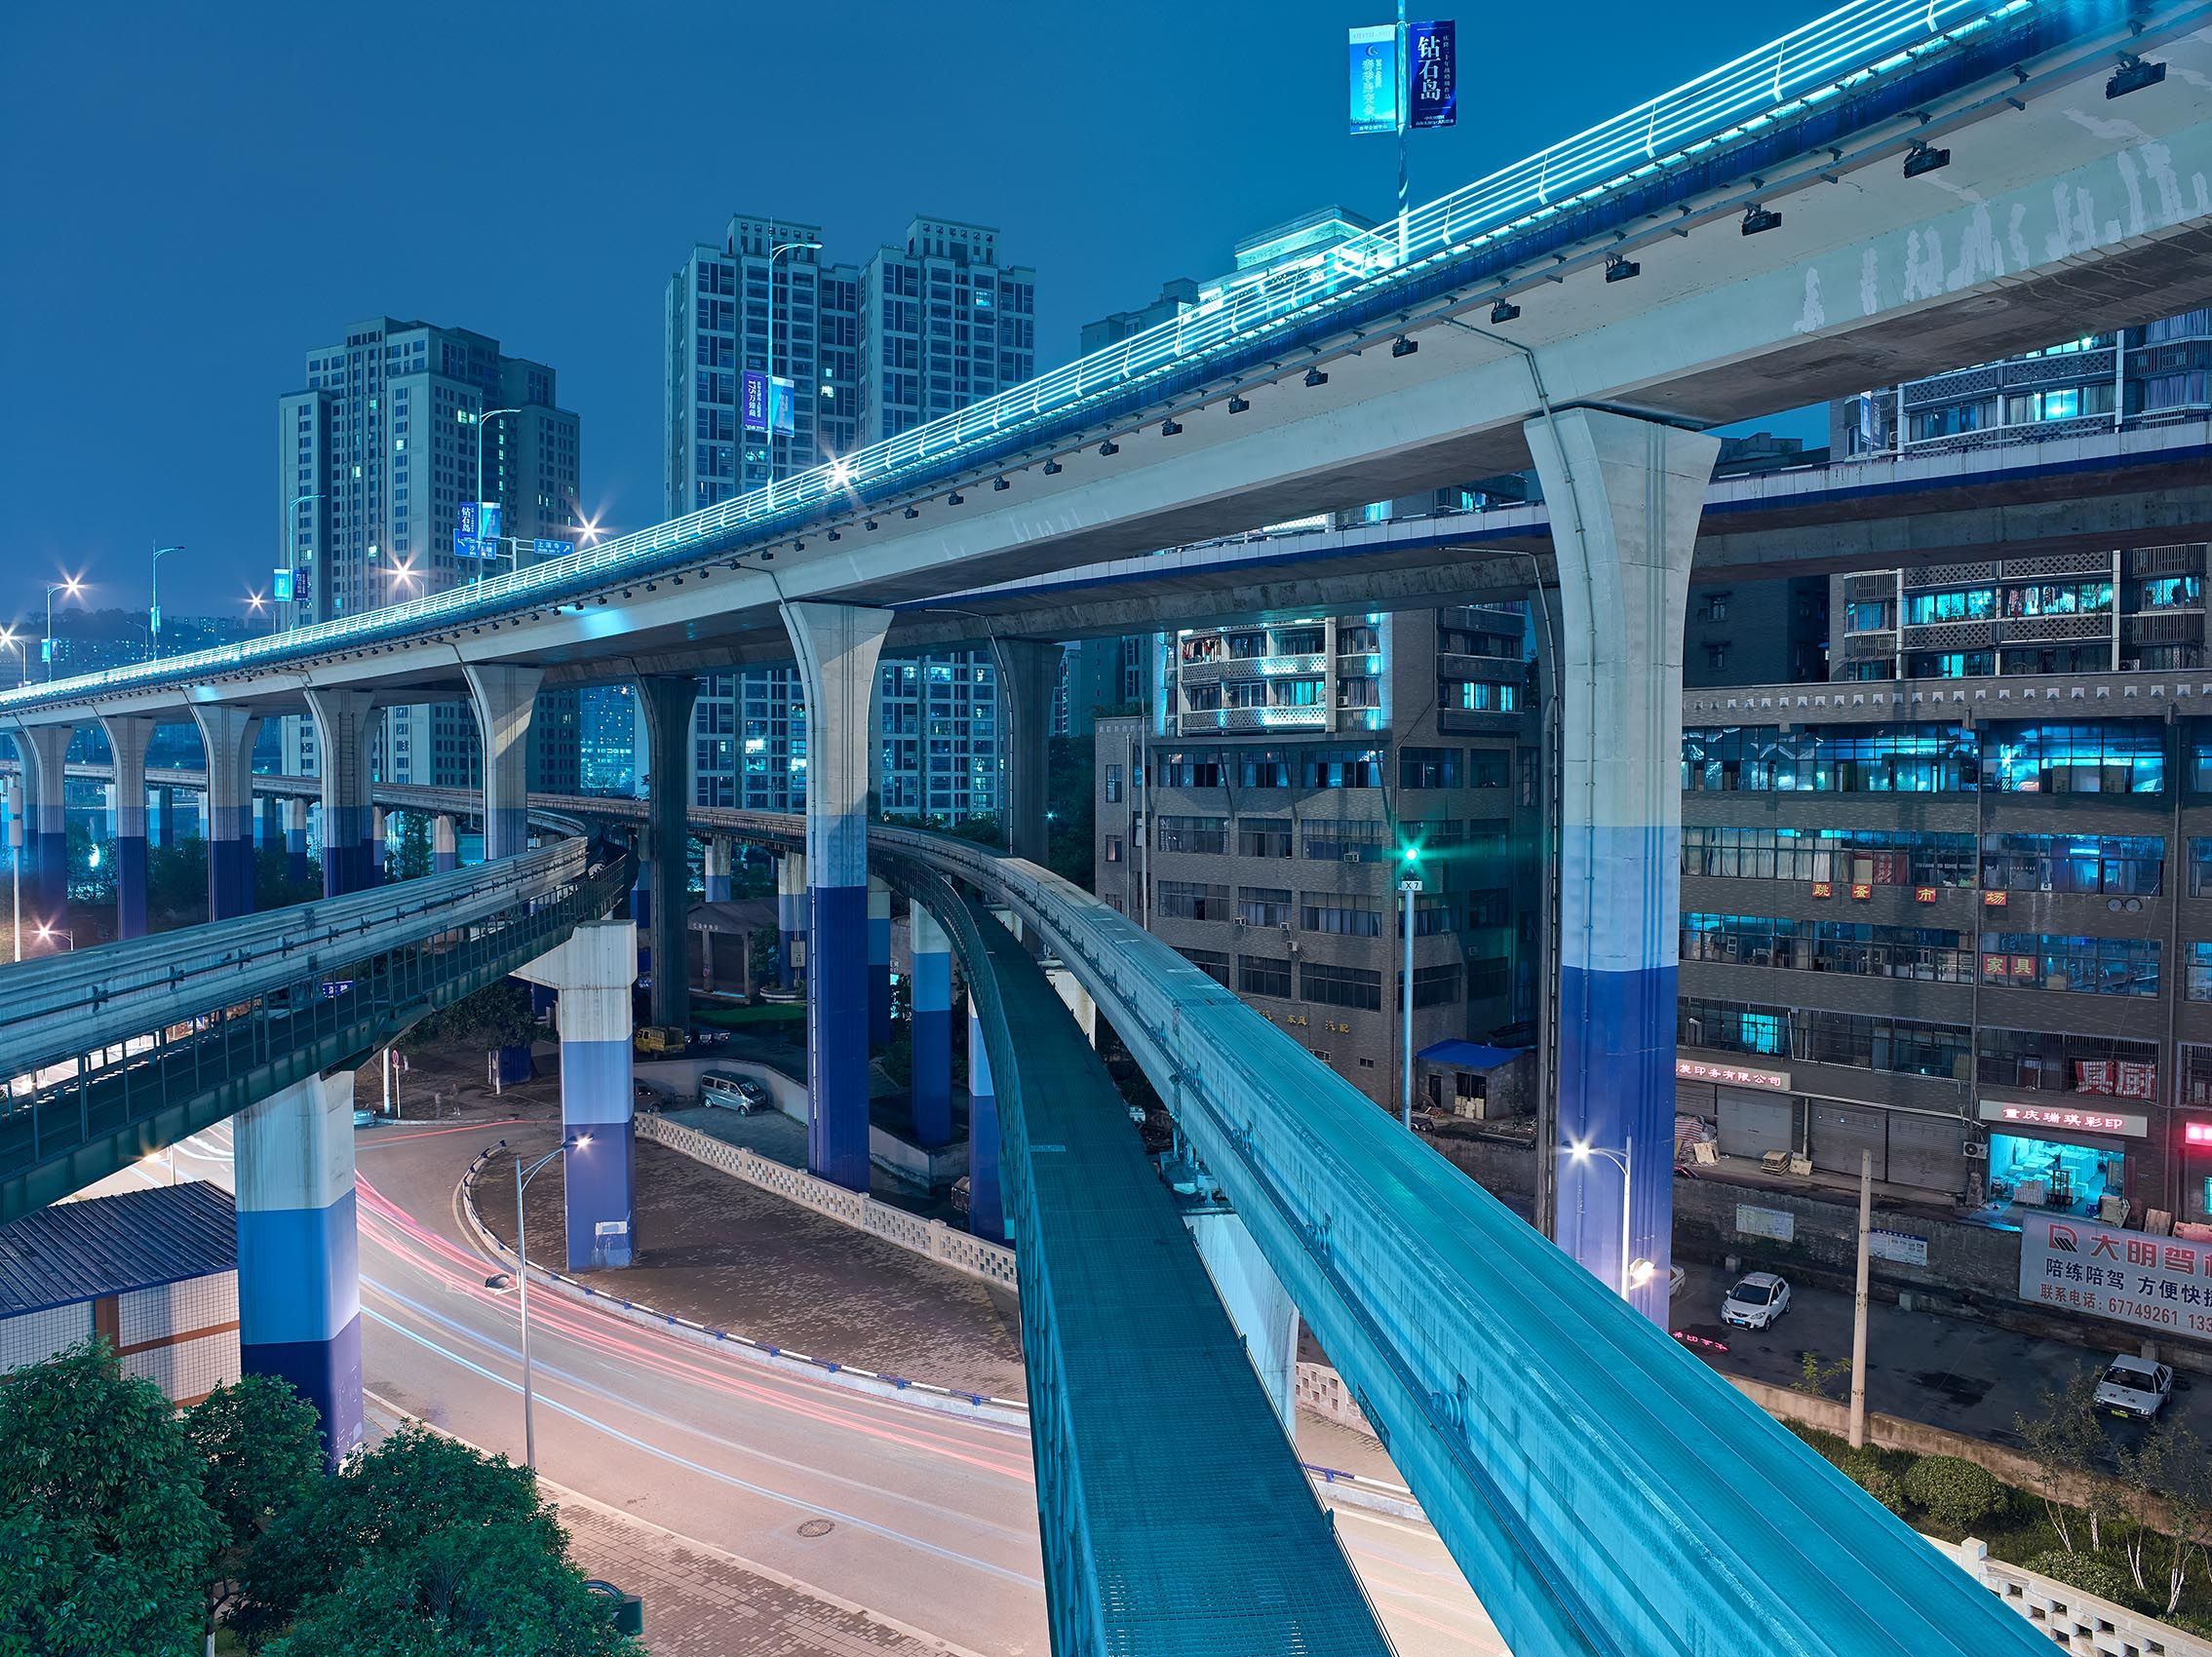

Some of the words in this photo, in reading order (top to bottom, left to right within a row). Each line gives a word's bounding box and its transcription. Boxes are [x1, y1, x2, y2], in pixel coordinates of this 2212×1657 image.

[1417, 35, 1442, 100] 钻石岛
[461, 506, 470, 532] 钻石岛
[1814, 883, 2005, 905] 跳蚤市场
[1987, 956, 2032, 974] 家具
[2045, 1257, 2124, 1291] 陪练陪驾
